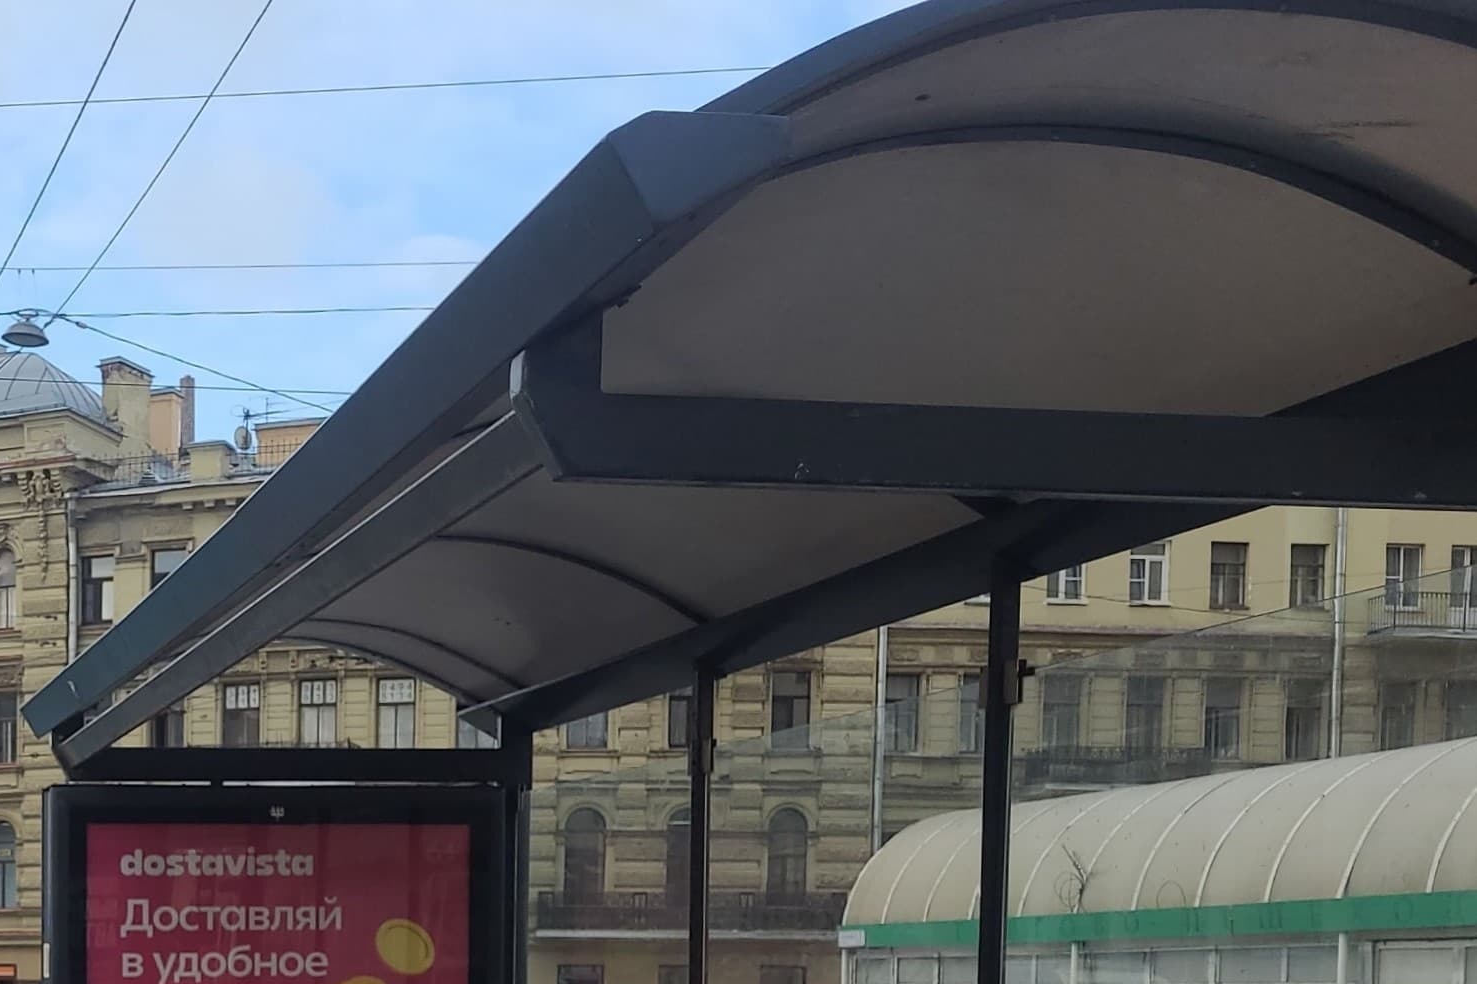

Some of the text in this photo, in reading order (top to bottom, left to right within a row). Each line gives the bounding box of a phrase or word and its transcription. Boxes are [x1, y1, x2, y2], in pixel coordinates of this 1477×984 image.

[120, 847, 314, 876] dostavista
[120, 896, 343, 937] Доставляй
[122, 952, 144, 978] в
